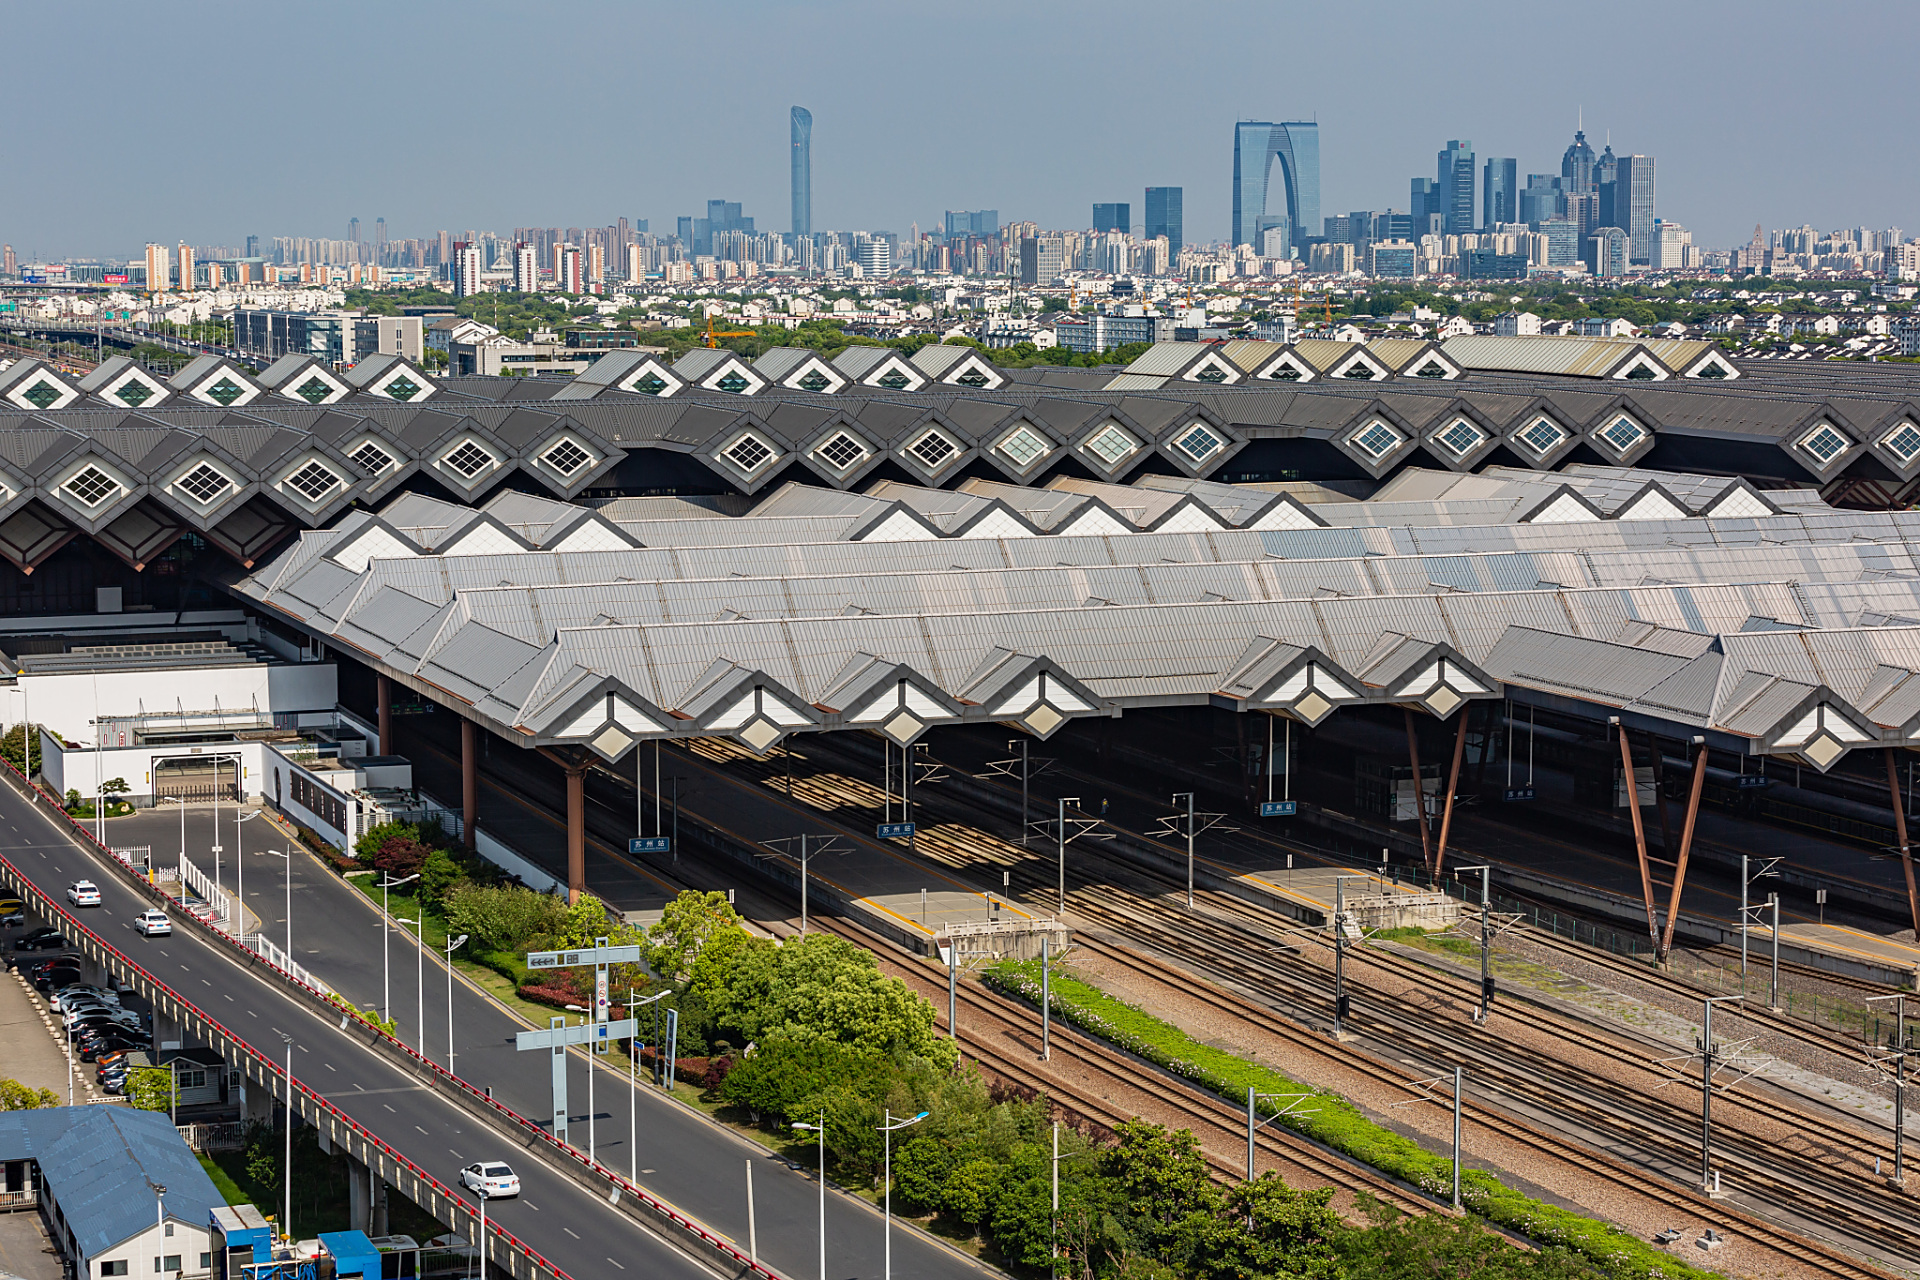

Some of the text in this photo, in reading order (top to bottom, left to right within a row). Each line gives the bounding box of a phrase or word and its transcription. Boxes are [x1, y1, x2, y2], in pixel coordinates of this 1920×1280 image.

[425, 704, 434, 712] 12
[882, 825, 911, 834] 苏州站
[635, 839, 665, 848] 苏州站
